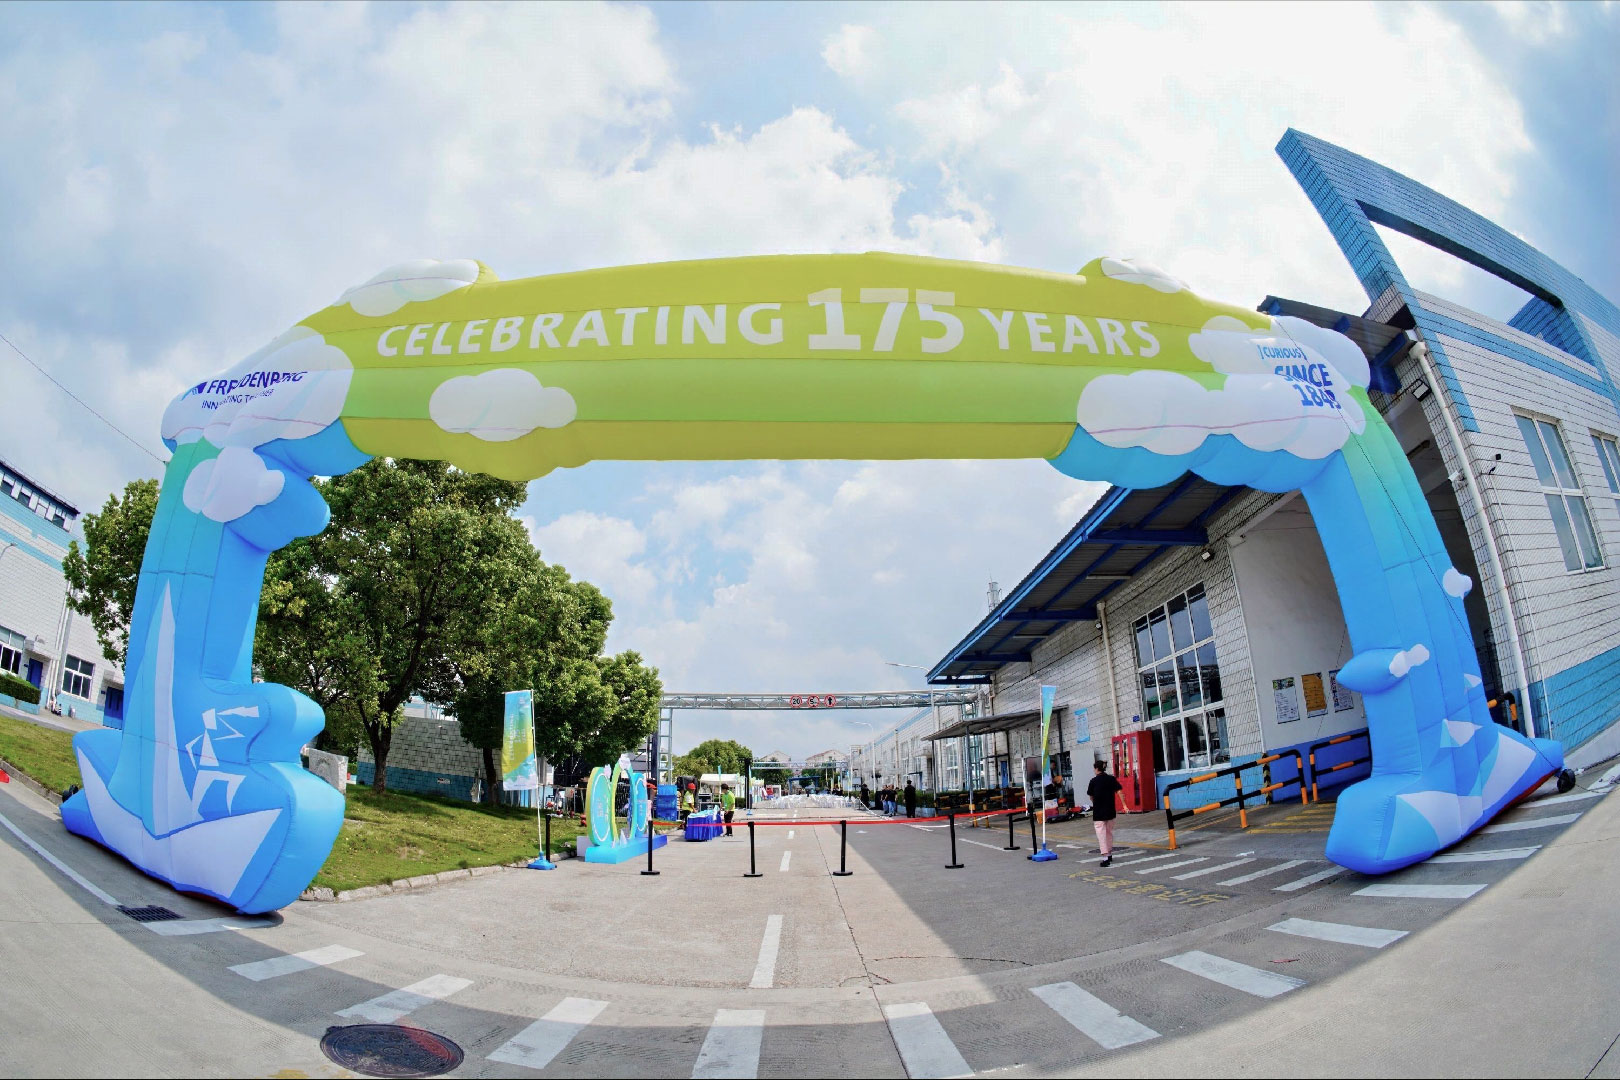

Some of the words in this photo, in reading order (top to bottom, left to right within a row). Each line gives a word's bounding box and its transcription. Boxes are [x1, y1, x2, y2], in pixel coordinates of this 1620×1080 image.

[377, 302, 784, 357] CELEBRATING
[807, 288, 964, 354] 175
[978, 308, 1160, 358] YEARS
[1274, 363, 1333, 388] SINCE
